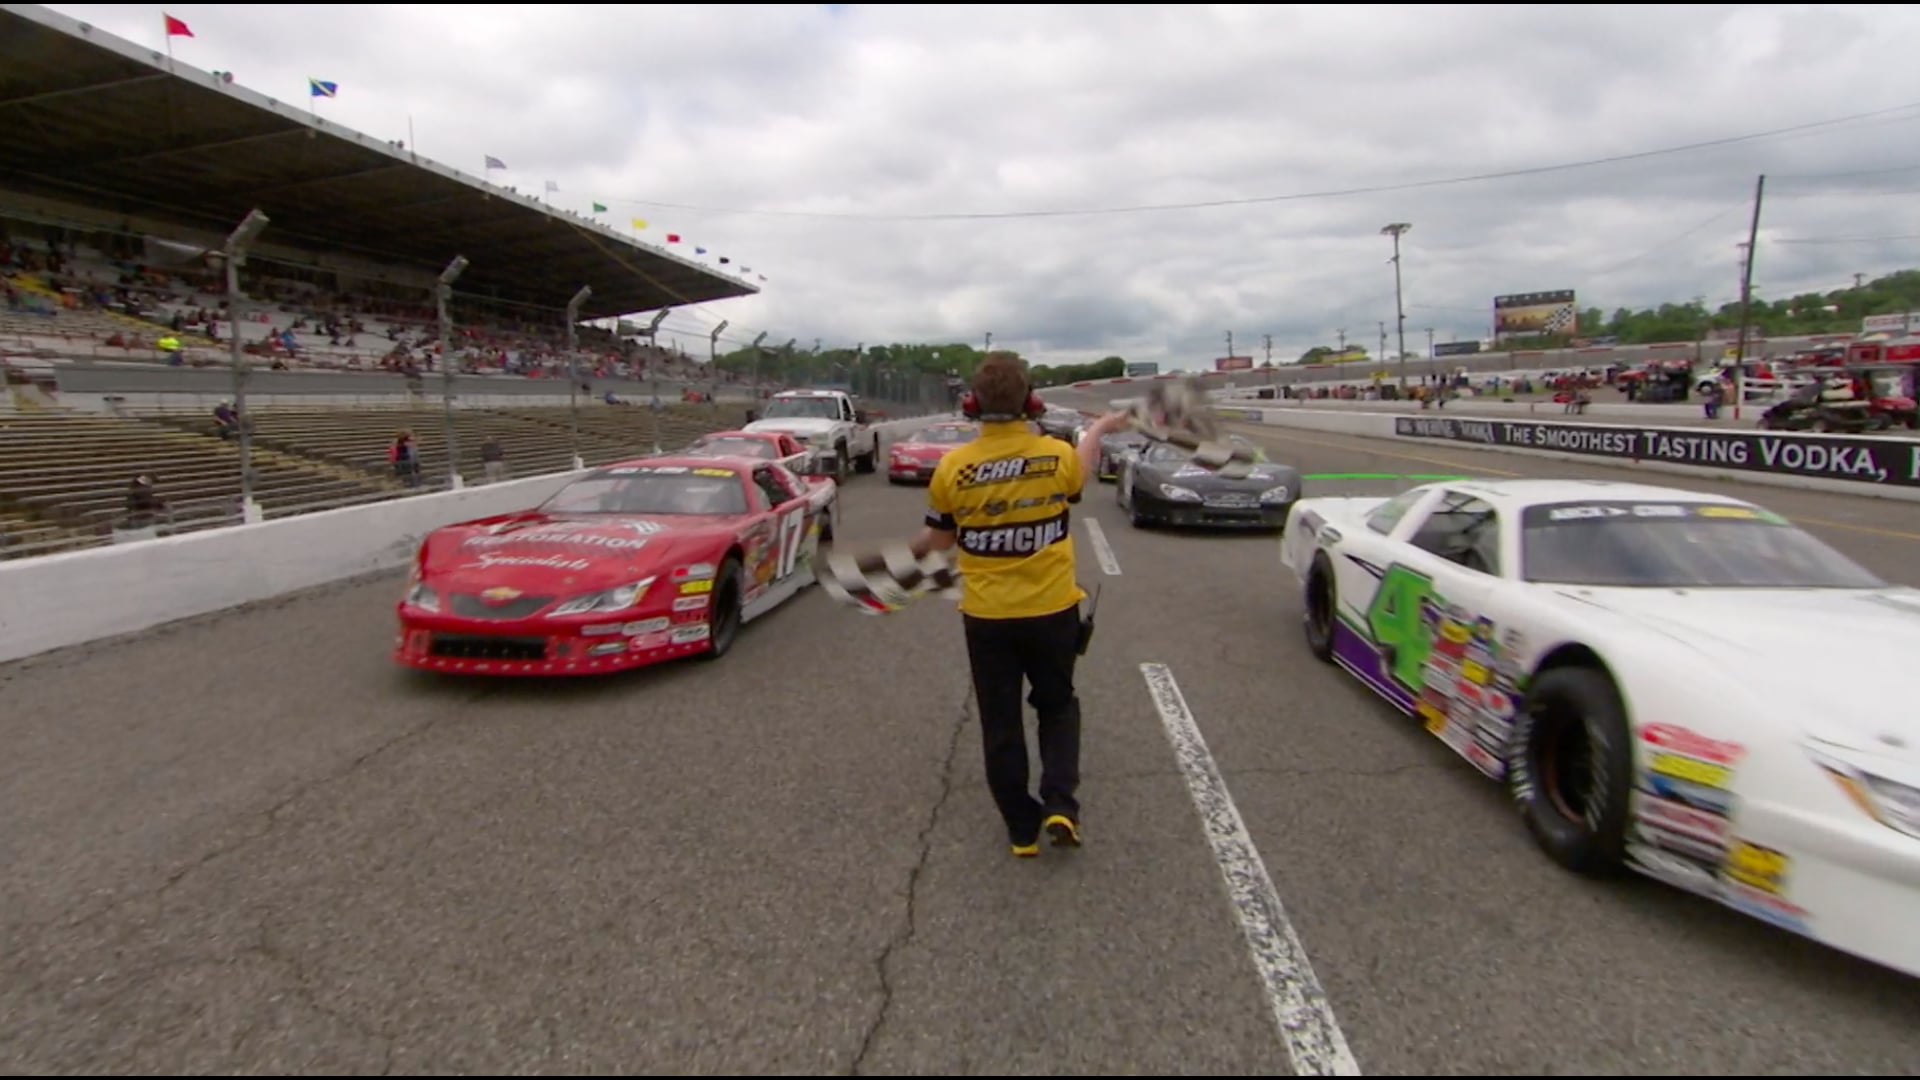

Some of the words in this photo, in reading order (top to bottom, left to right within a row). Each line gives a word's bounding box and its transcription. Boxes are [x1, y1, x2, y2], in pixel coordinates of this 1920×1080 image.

[974, 457, 1025, 483] CRA
[1503, 424, 1532, 443] THE
[1535, 425, 1638, 453] SMOOTHEST
[1644, 431, 1748, 463] TASTING
[1758, 438, 1888, 482] VODKA,
[776, 507, 804, 580] 17
[963, 519, 1063, 552] OFFICIAL
